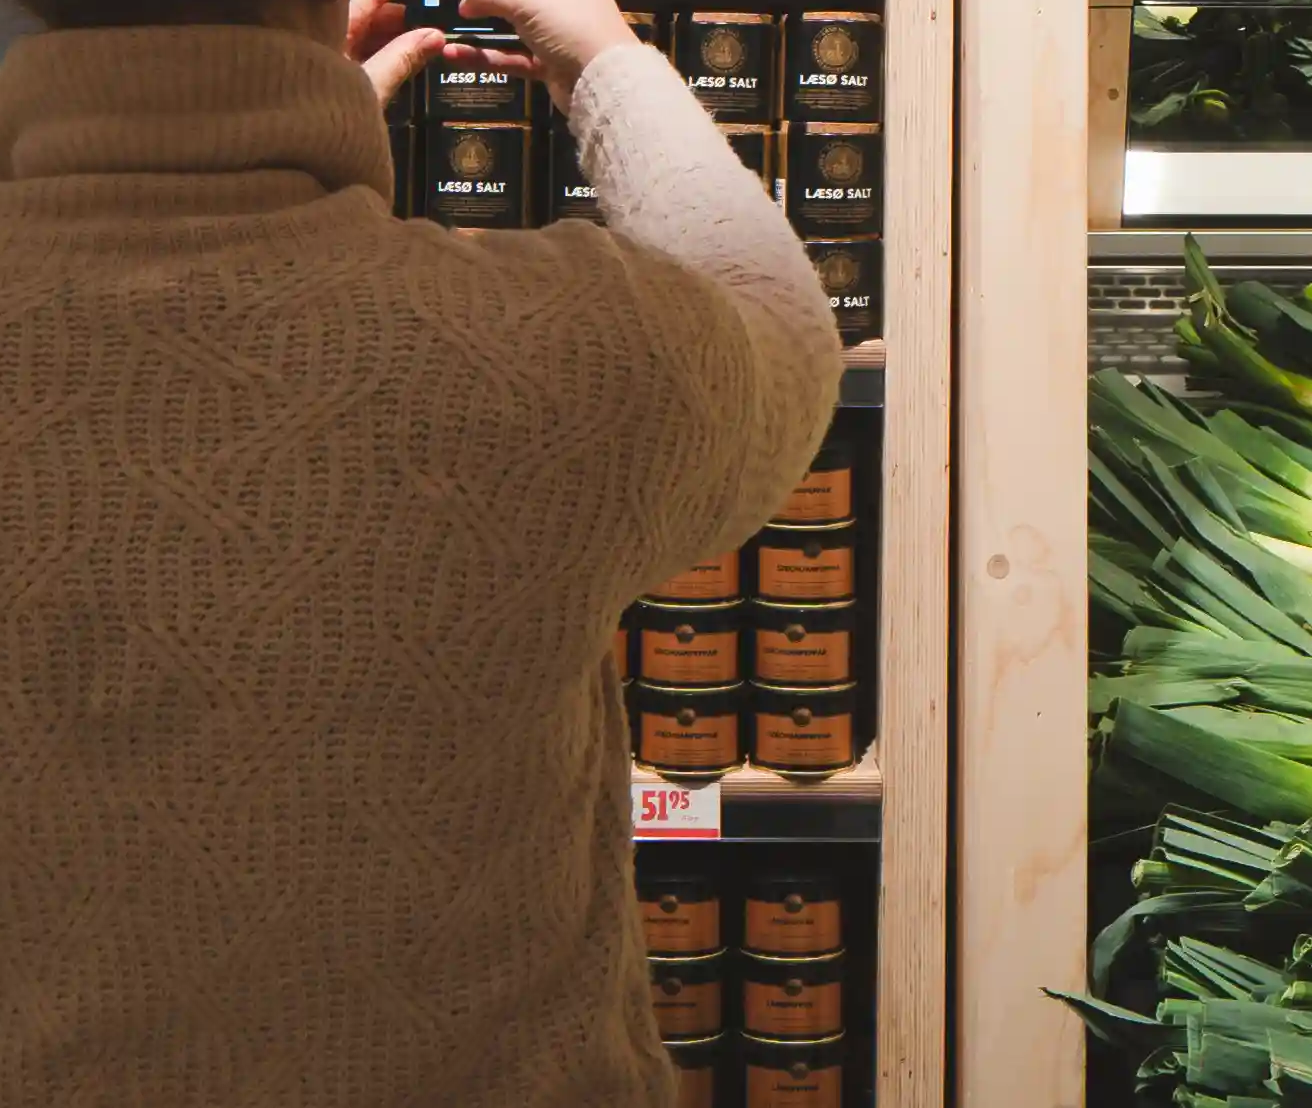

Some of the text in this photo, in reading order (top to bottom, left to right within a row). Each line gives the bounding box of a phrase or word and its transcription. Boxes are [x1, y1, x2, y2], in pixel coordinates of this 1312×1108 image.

[440, 72, 508, 84] LÆSØ SALT
[688, 76, 758, 89] LÆSØ SALT
[799, 74, 869, 87] LÆSØ SALT
[438, 181, 506, 193] LÆSØ SALT
[805, 187, 872, 199] LÆSØ SALT
[843, 296, 870, 308] SALT
